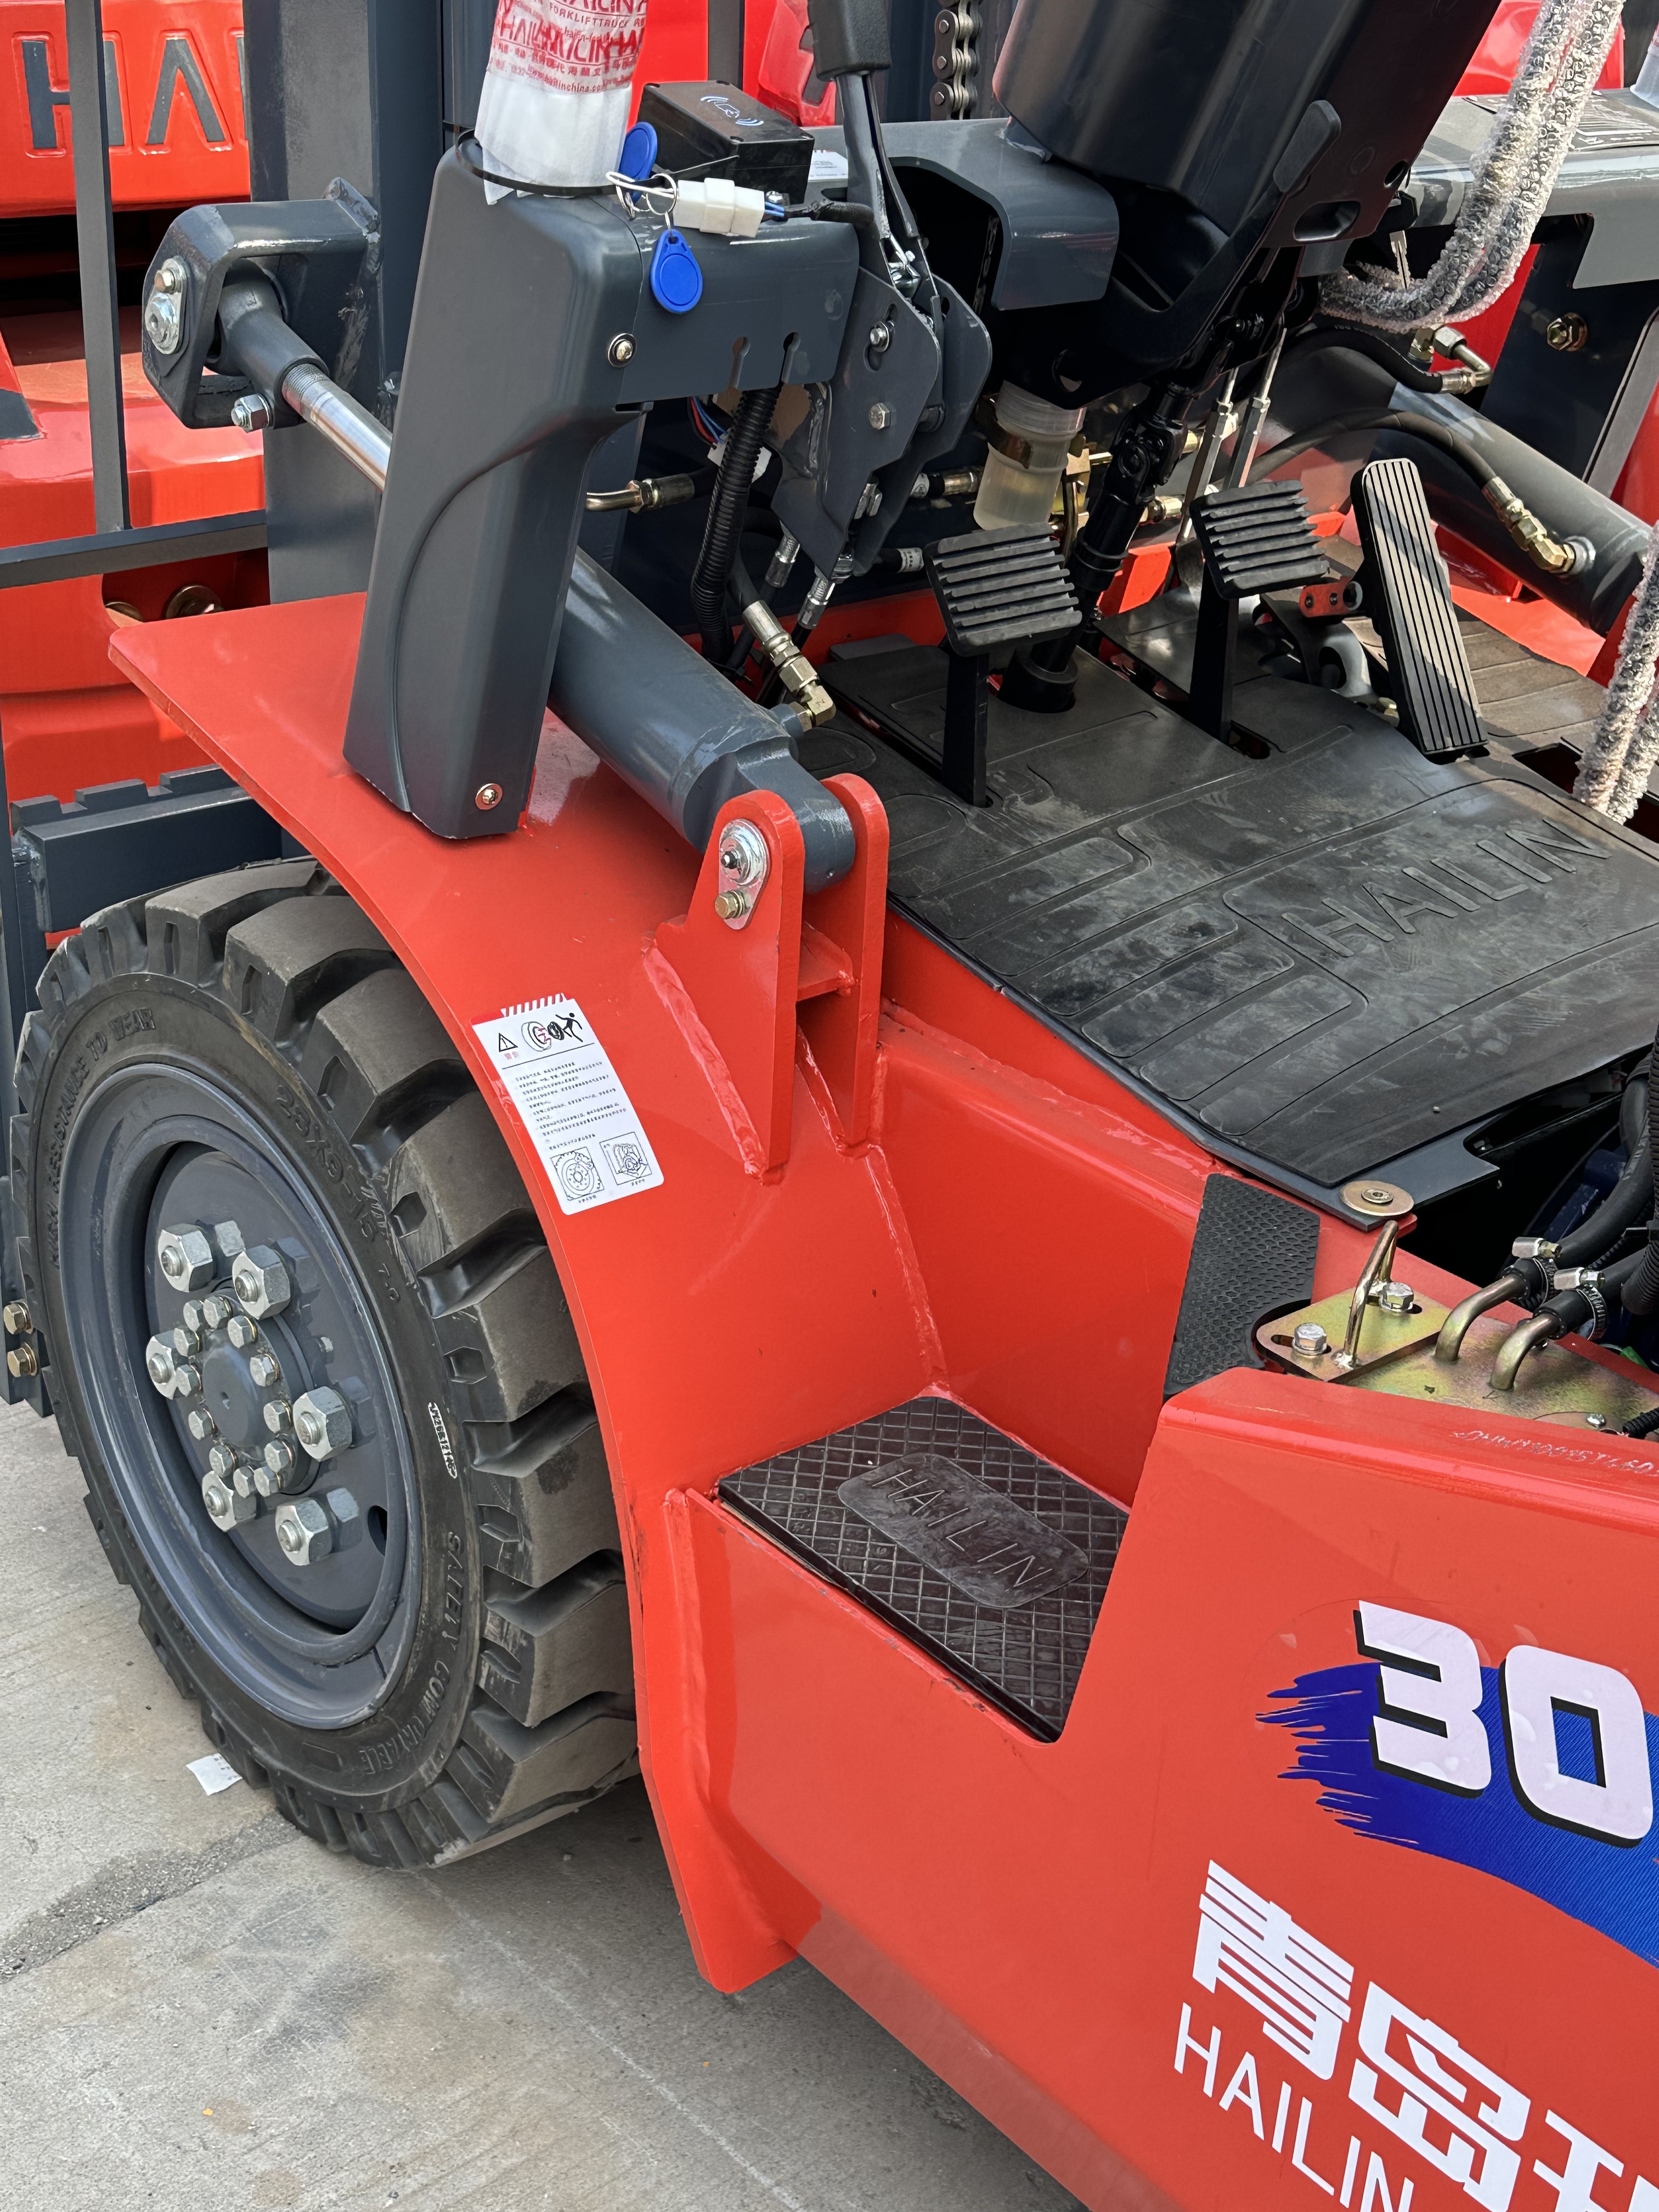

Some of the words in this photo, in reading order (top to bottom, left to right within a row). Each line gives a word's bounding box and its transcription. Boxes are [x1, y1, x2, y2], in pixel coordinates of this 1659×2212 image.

[20, 35, 249, 150] HA
[1280, 819, 1612, 958] HAILIN
[871, 1469, 1053, 1588] HAILIN
[1352, 1600, 1654, 1848] 30
[1173, 2002, 1414, 2212] HAILIN
